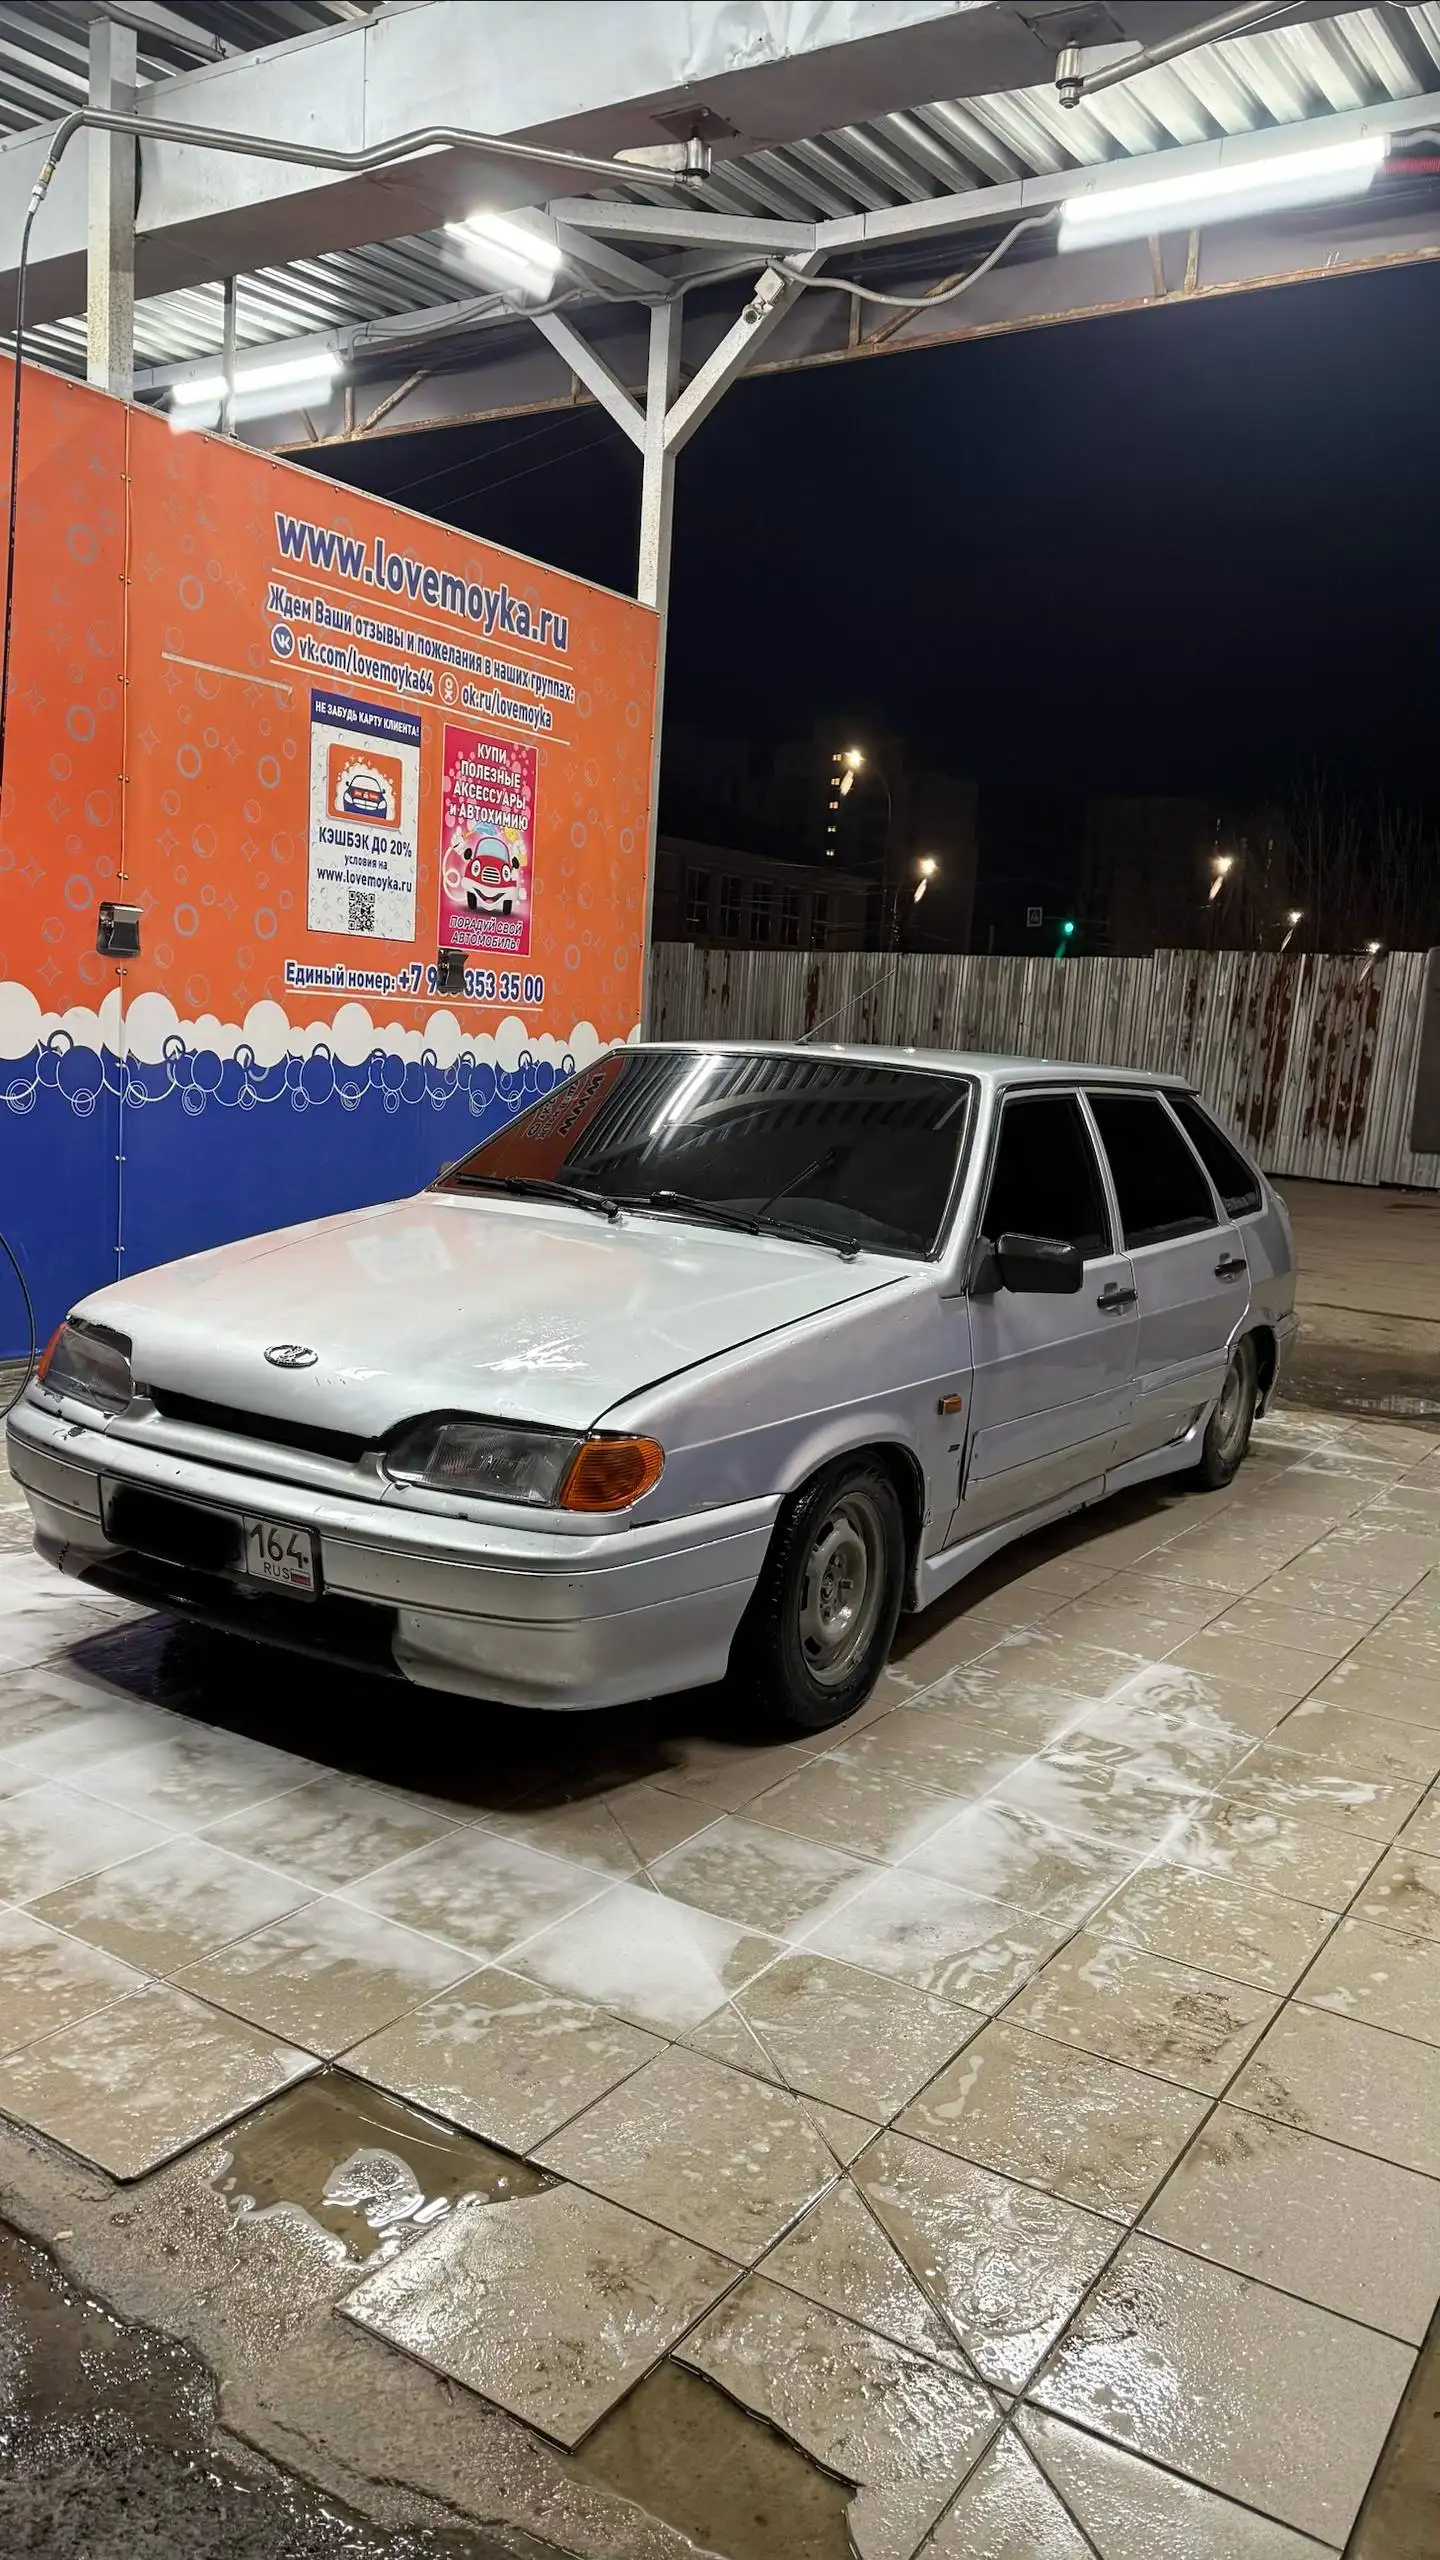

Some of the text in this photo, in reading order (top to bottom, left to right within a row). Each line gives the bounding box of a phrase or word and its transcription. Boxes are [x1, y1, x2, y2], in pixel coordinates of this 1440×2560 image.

[275, 513, 568, 651] www.lovemoyka.ru
[268, 584, 574, 701] Ждем Ваши отзывы и пожелания в наших группах:
[299, 636, 433, 695] vk.com/lovemoyka64
[462, 684, 552, 729] ok.ru/lovemoyka
[315, 700, 420, 737] НЕ ЗАБУДЬ КАРТУ КЛИЕНТА!
[477, 742, 507, 764] КУПИ
[461, 760, 521, 788] ПОЛЕЗНЫЕ
[453, 780, 526, 810] АКСЕССУАРЫ
[459, 803, 529, 831] АВТОХИМИЮ
[319, 826, 412, 858] КЭШБЭК ДО 20%
[344, 854, 388, 870] условия на
[316, 867, 412, 893] www.lovemoyka.ru
[450, 915, 523, 936] ПОРАДУЙ СВОЙ
[451, 931, 520, 950] АВТОМОБИЛЬ!
[285, 961, 345, 986] Единый
[348, 971, 395, 994] номер:
[398, 963, 422, 992] +7
[464, 969, 496, 998] 353
[500, 973, 521, 1001] 35
[524, 975, 544, 1002] 00
[250, 1523, 303, 1569] 164
[263, 1561, 291, 1580] RUS
